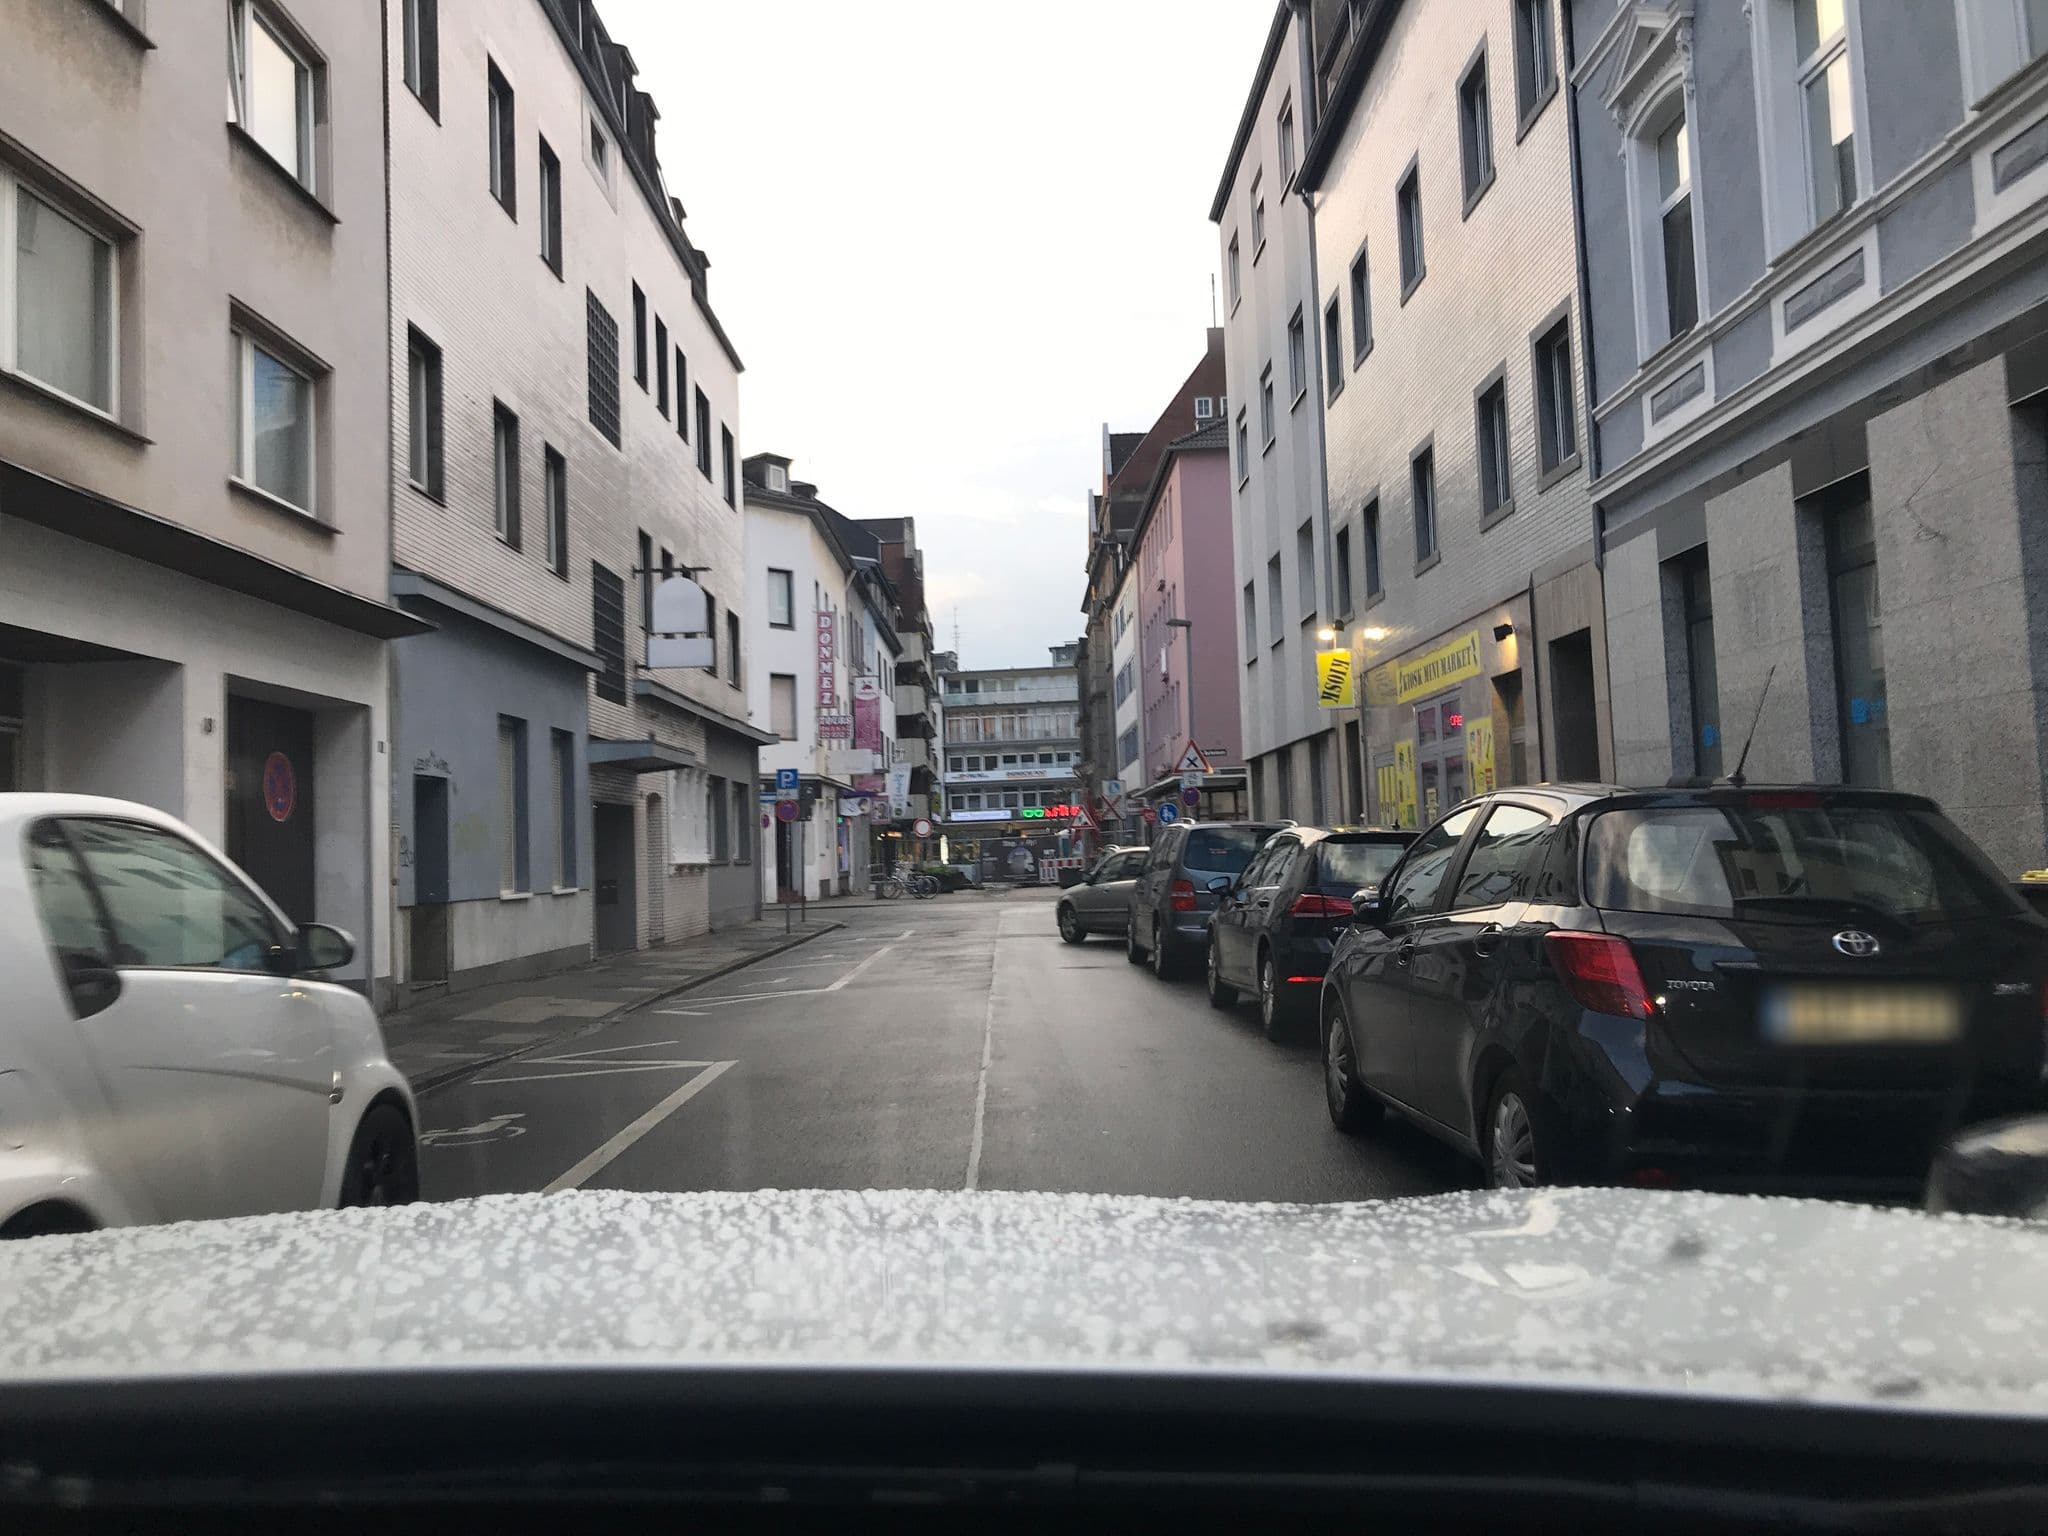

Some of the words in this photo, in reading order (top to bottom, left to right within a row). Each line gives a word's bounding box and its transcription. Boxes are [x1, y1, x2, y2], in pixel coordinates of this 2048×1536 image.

[1321, 658, 1350, 704] KIOSK
[781, 771, 794, 788] P
[1666, 980, 1716, 991] TOYOTA
